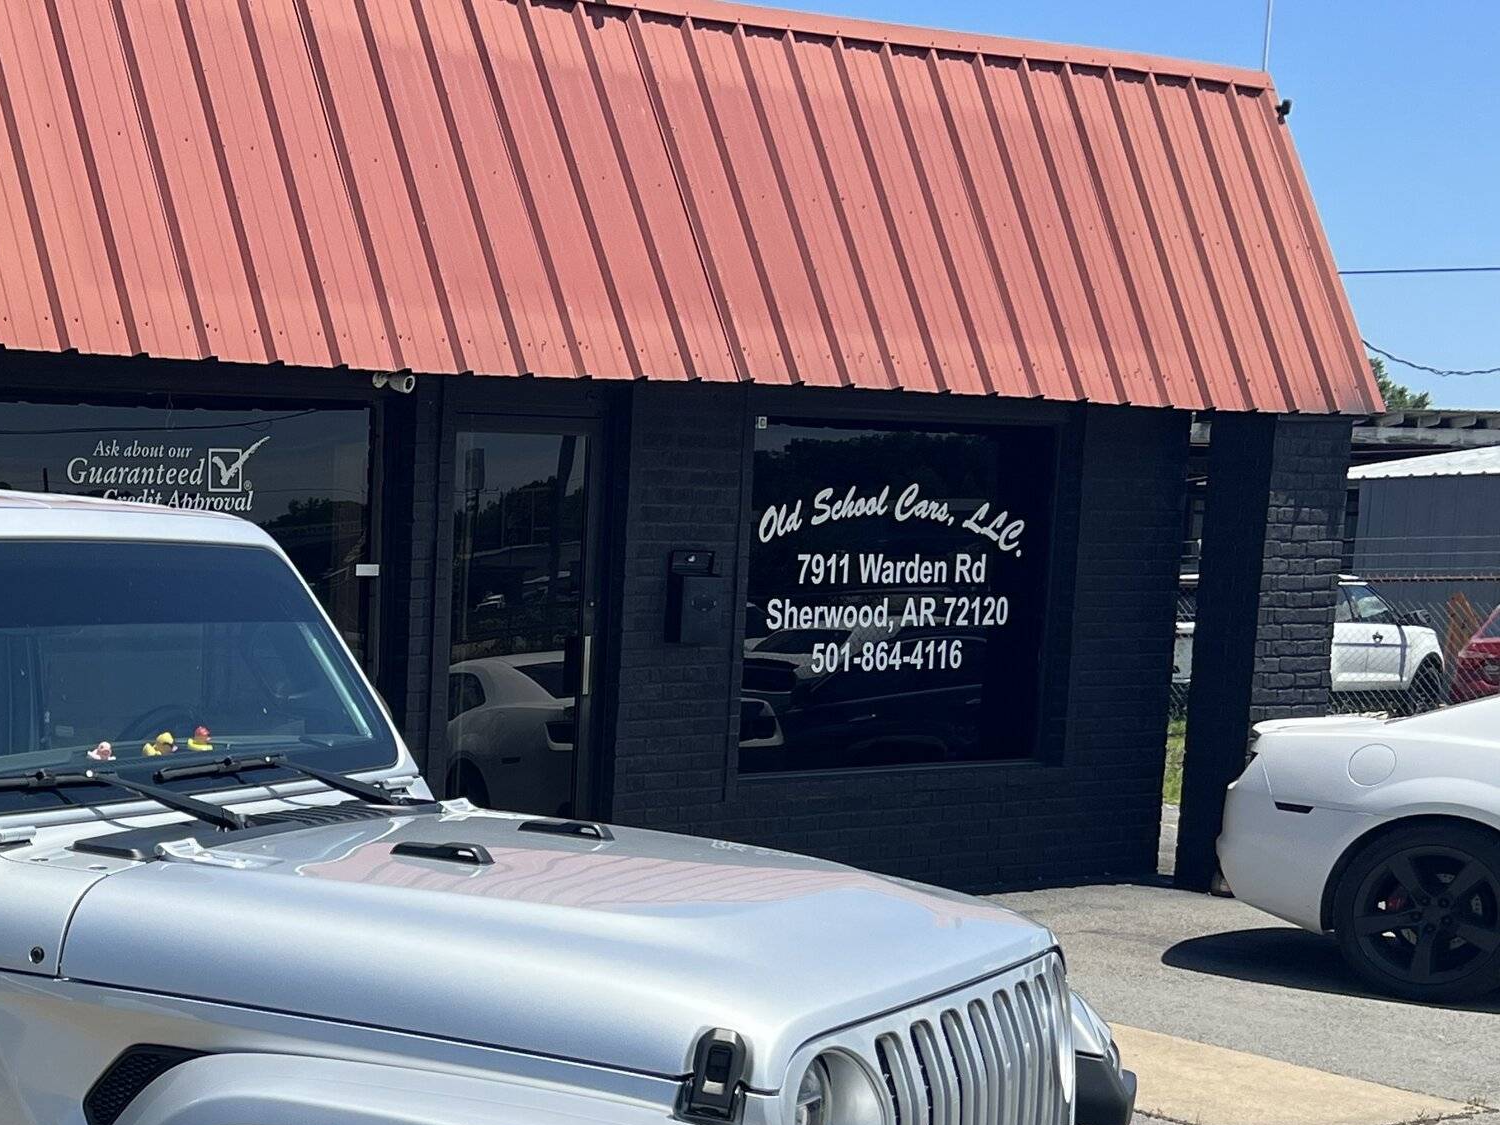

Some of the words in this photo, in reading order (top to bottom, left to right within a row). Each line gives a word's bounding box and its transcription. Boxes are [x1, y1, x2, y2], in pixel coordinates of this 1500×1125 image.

[92, 439, 120, 457] Ask
[123, 439, 165, 458] about
[168, 446, 193, 458] our
[66, 457, 206, 486] Guaranteed
[758, 499, 803, 543] Old
[810, 485, 890, 526] School
[894, 483, 955, 526] Cars,
[797, 553, 850, 584] 7911
[859, 553, 947, 584] Warden
[955, 552, 987, 583] Rd
[766, 597, 893, 633] Sherwood,
[900, 597, 936, 628] AR
[943, 596, 1009, 627] 72120
[810, 640, 963, 673] 501-864-4116
